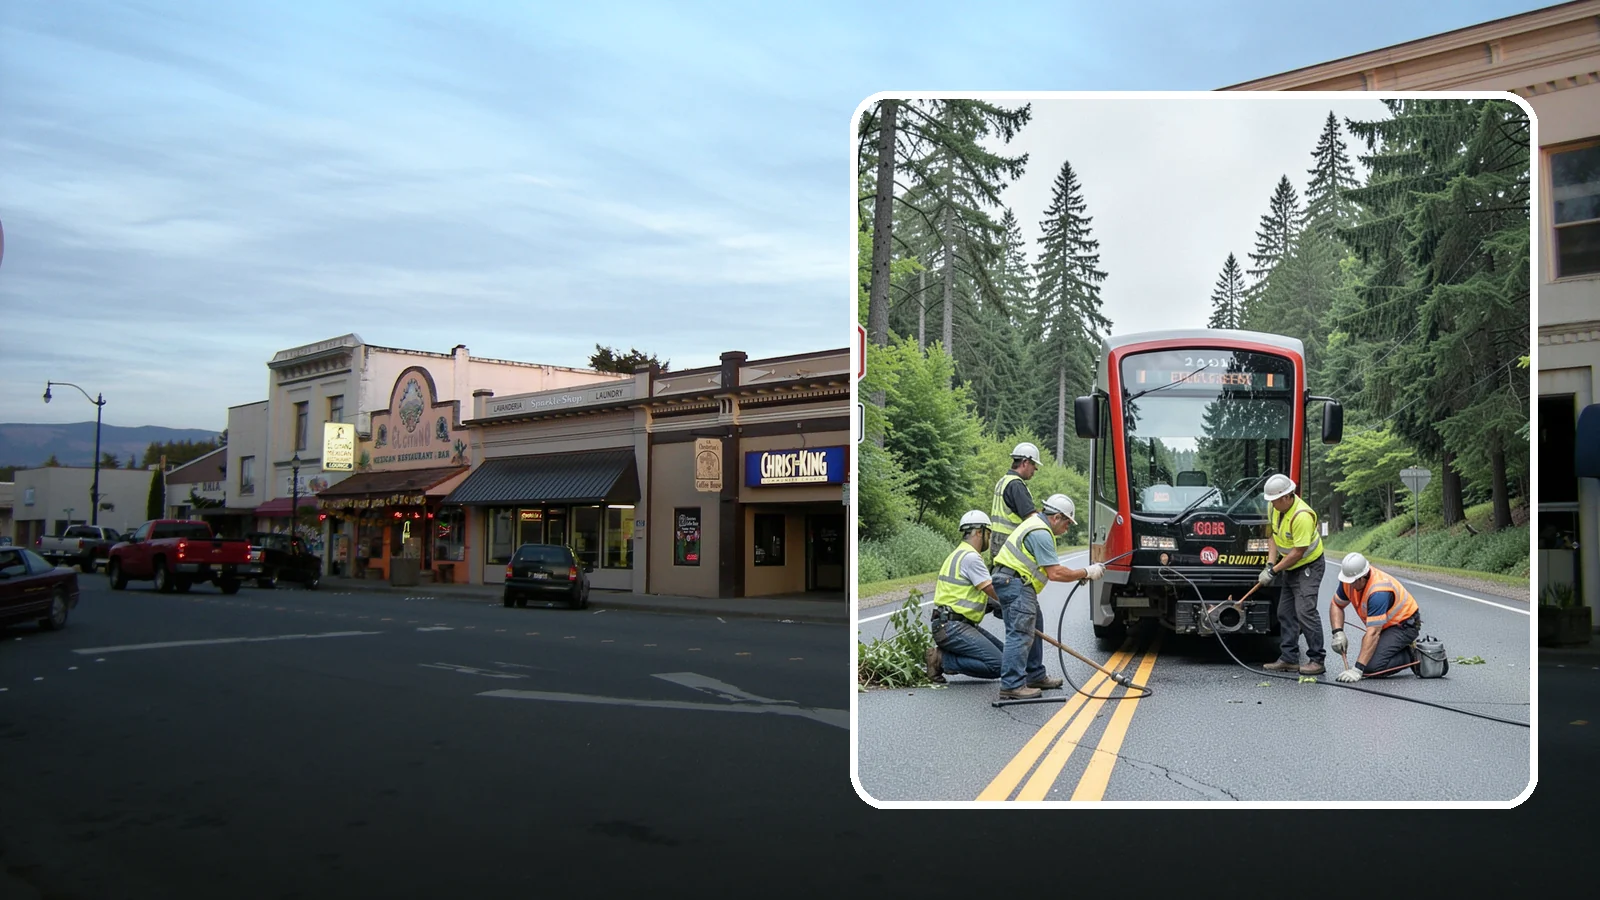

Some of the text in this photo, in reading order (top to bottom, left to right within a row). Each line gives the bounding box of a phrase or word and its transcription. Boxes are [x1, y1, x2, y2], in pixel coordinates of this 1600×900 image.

[595, 388, 624, 400] LAUNDRY
[493, 402, 523, 413] LAVANDERIA
[530, 394, 582, 408] Sparkle Shop
[373, 450, 450, 464] MEXICAN RESTAURANT BAR
[761, 450, 828, 478] CHRIST KING
[696, 480, 722, 489] Coffee House
